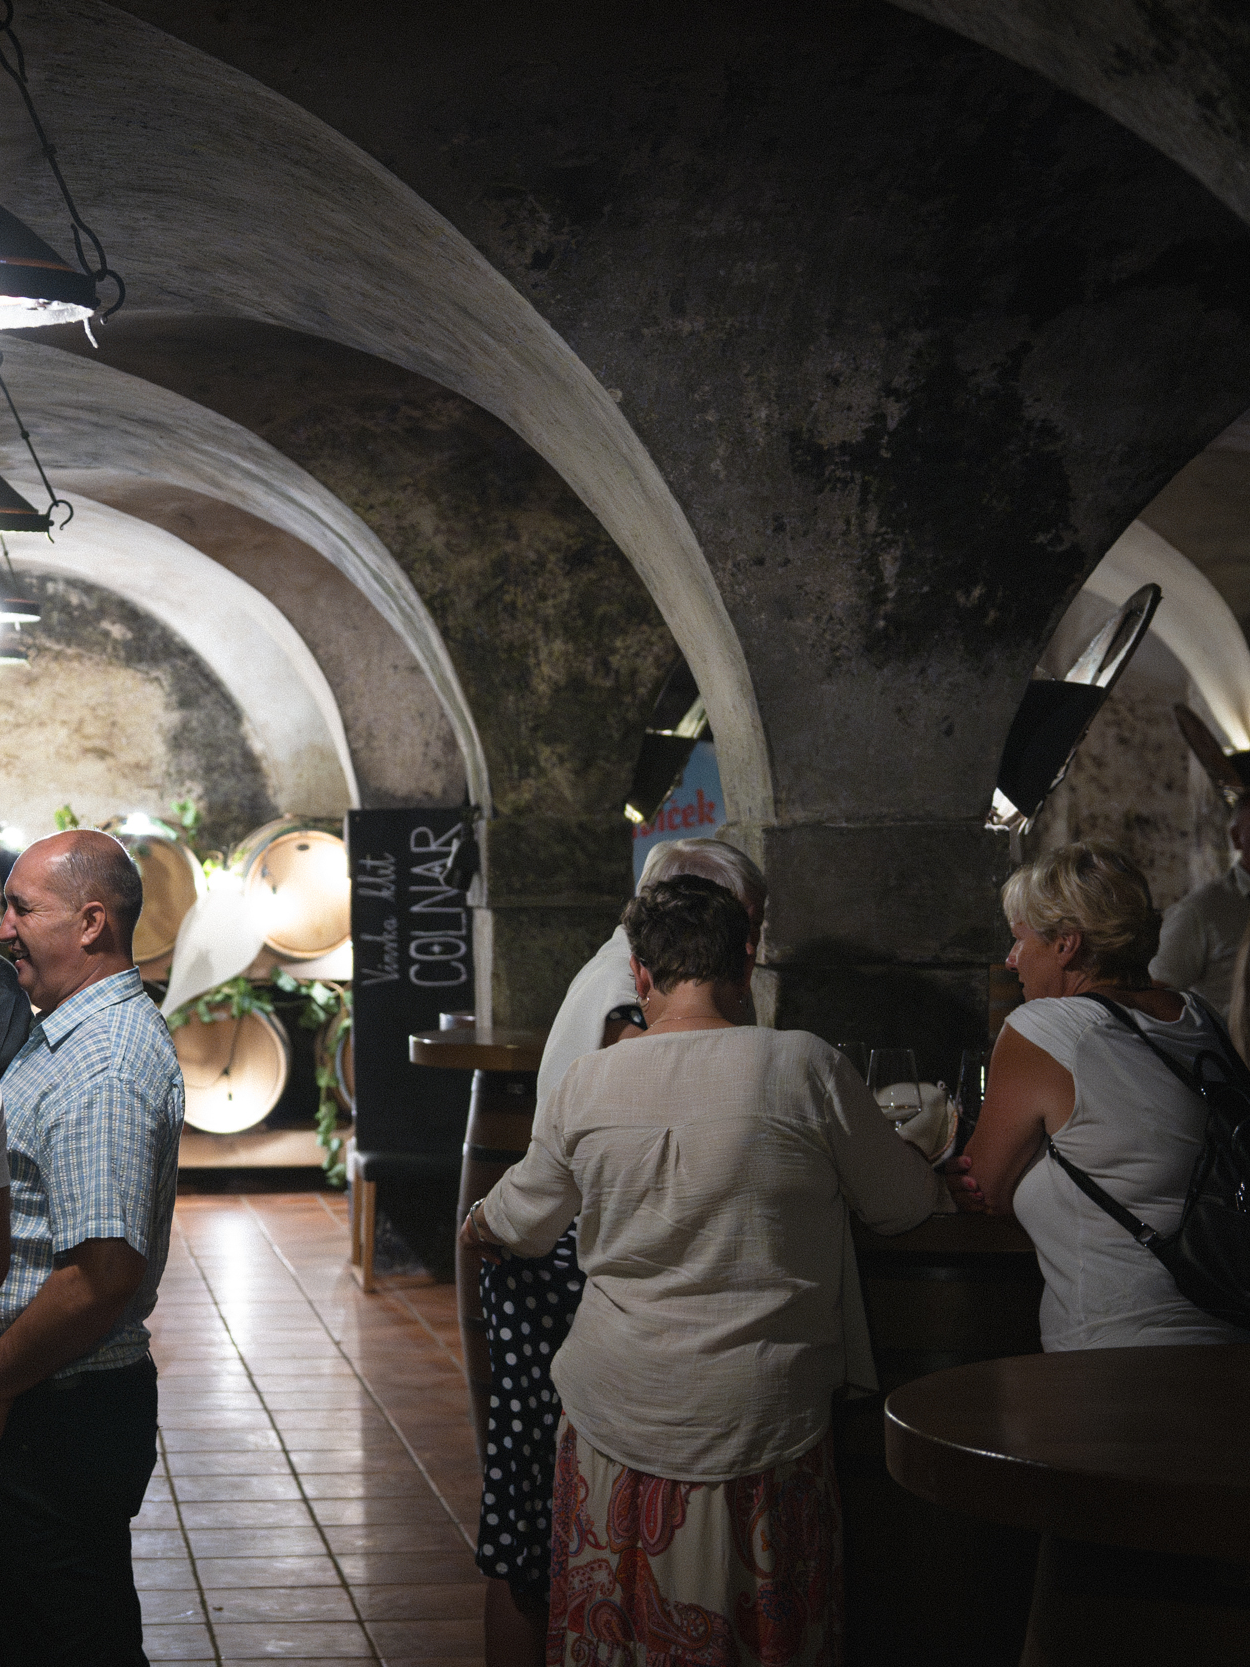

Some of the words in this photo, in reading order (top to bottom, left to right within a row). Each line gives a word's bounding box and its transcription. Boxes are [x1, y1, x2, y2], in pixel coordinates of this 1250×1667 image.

[356, 851, 397, 900] klet
[408, 822, 468, 988] COLNAR
[359, 915, 400, 986] Vinska
